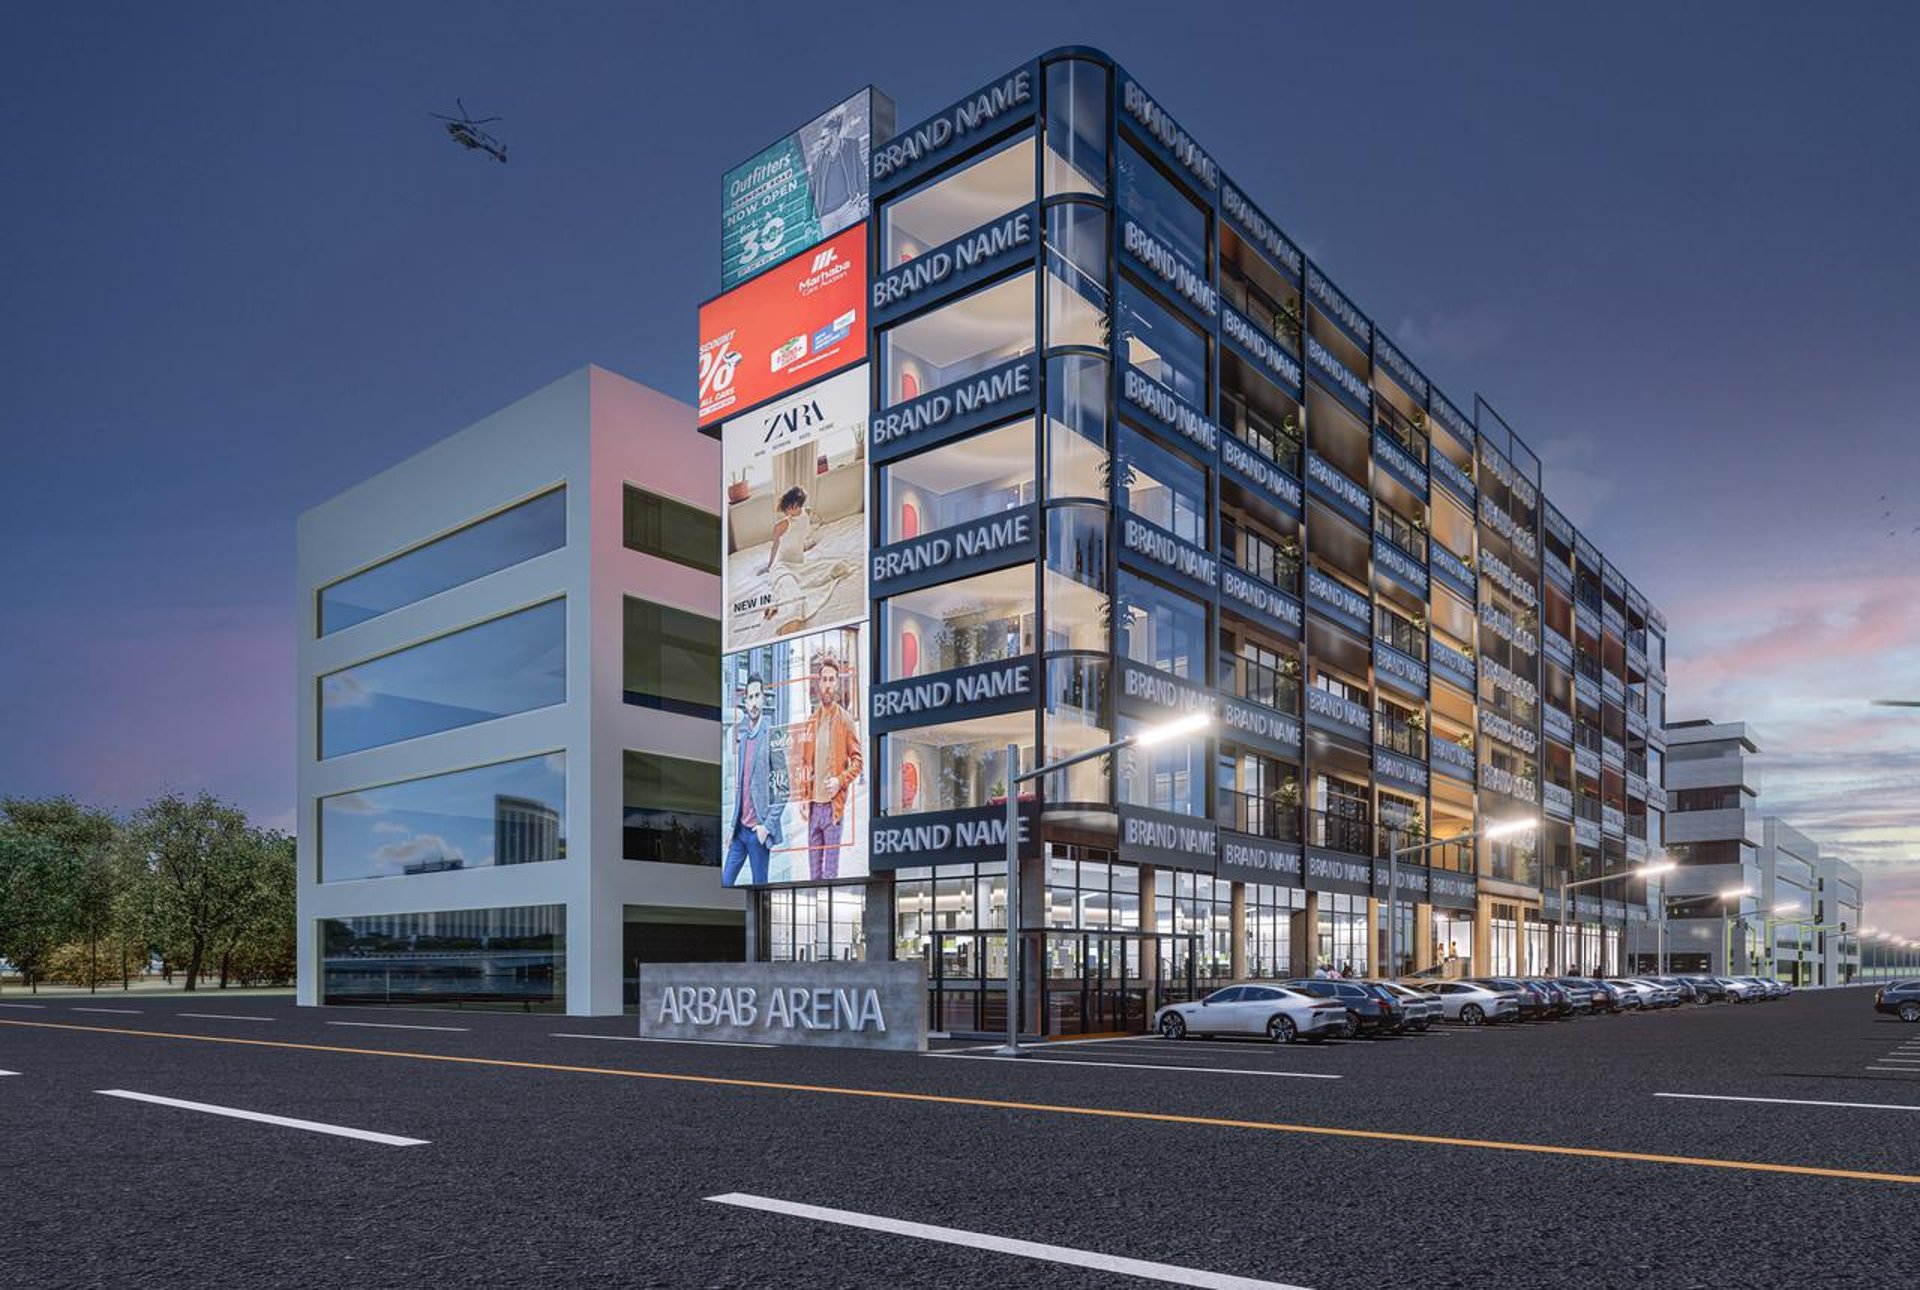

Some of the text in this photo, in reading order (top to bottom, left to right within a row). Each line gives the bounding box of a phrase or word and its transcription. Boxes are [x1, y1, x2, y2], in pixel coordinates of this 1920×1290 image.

[873, 71, 1031, 178] BRAND NAME
[731, 153, 791, 198] Outfitters
[726, 202, 758, 227] NOW
[761, 180, 797, 207] OPEN
[799, 260, 851, 292] Marhaba
[873, 212, 1030, 309] BRAND NAME
[1125, 221, 1217, 316] BRAND NAME
[1223, 309, 1301, 389] BRAND NAME
[764, 400, 824, 444] ZARA
[873, 395, 950, 444] BRAND
[956, 364, 1030, 414] NAME
[1125, 371, 1217, 451] BRAND NAME
[1222, 441, 1301, 508] BRAND NAME
[1309, 456, 1343, 492] BRAND
[873, 515, 1030, 580] BRAND NAME
[1125, 520, 1217, 586] BRAND NAME
[734, 598, 757, 613] NEW
[760, 594, 772, 606] IN
[1222, 572, 1301, 627] BRAND NAME
[1309, 574, 1370, 624] BRAND NAME
[873, 666, 1030, 717] BRAND NAME
[1125, 669, 1177, 707] BRAND
[1309, 691, 1343, 720] BRAND
[1225, 704, 1301, 747] BRAND NAME
[873, 824, 950, 854] BRAND
[1125, 818, 1217, 855] BRAND NAME
[1225, 843, 1301, 875] BRAND NAME
[1309, 857, 1371, 884] BRAND NAME
[658, 985, 887, 1034] ARBAB ARENA
